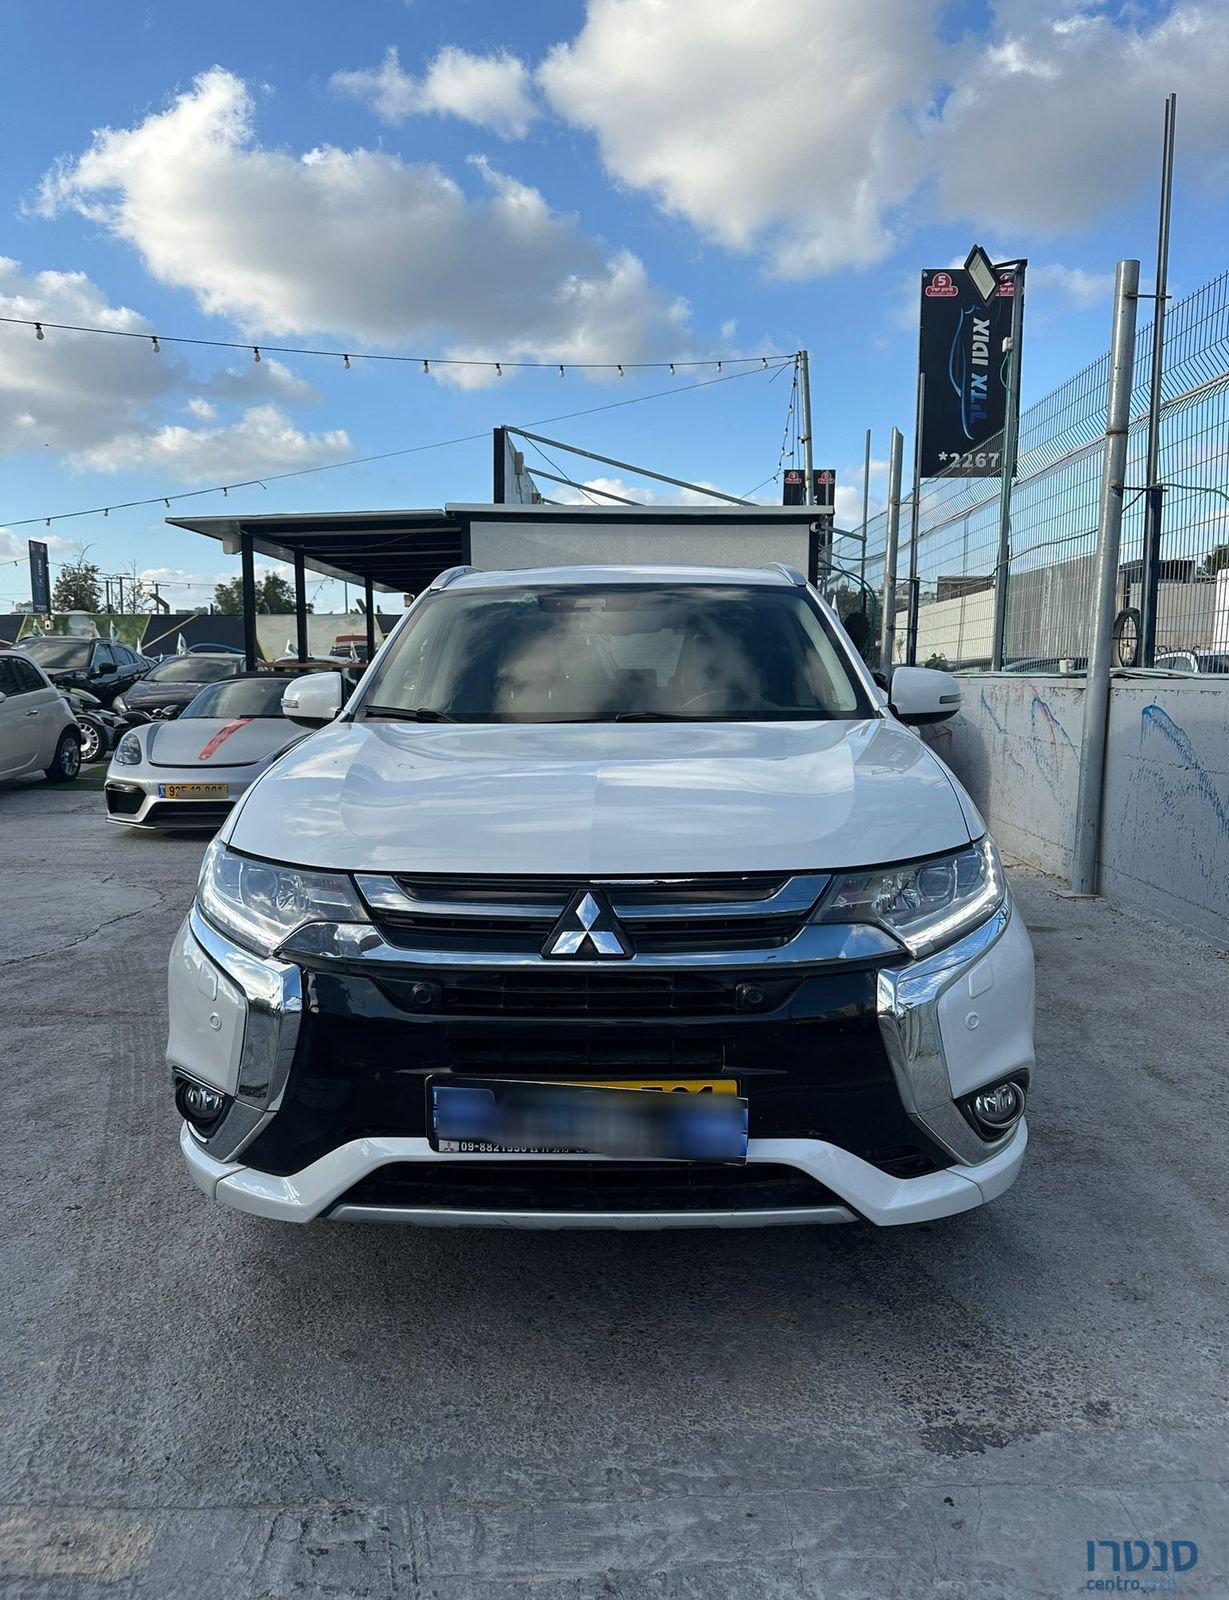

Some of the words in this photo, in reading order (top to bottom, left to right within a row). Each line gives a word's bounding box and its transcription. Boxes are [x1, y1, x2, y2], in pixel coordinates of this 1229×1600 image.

[938, 276, 947, 286] 5
[971, 317, 991, 366] אוטו
[970, 372, 989, 424] אדיר
